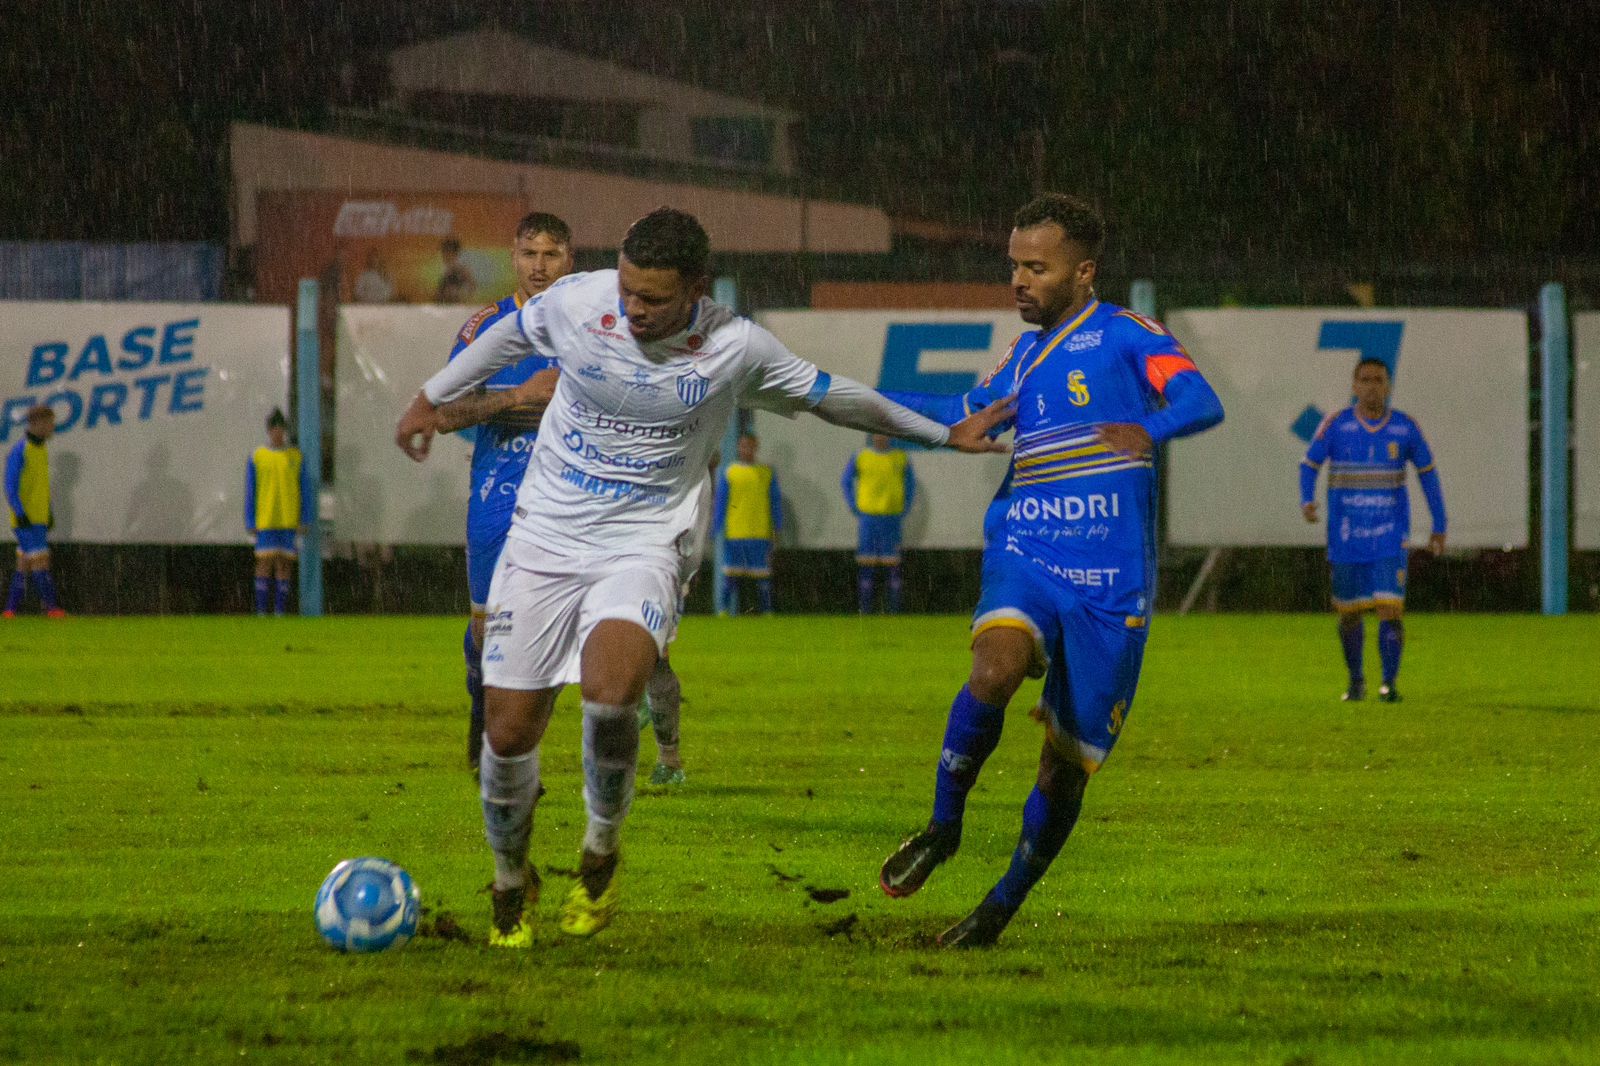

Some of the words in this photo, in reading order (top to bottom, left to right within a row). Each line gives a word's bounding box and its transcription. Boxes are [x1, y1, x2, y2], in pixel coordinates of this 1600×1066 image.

[27, 317, 201, 388] BASE
[0, 366, 210, 442] FORTE
[585, 443, 686, 470] DoctorClin
[1005, 492, 1120, 521] MONDRI
